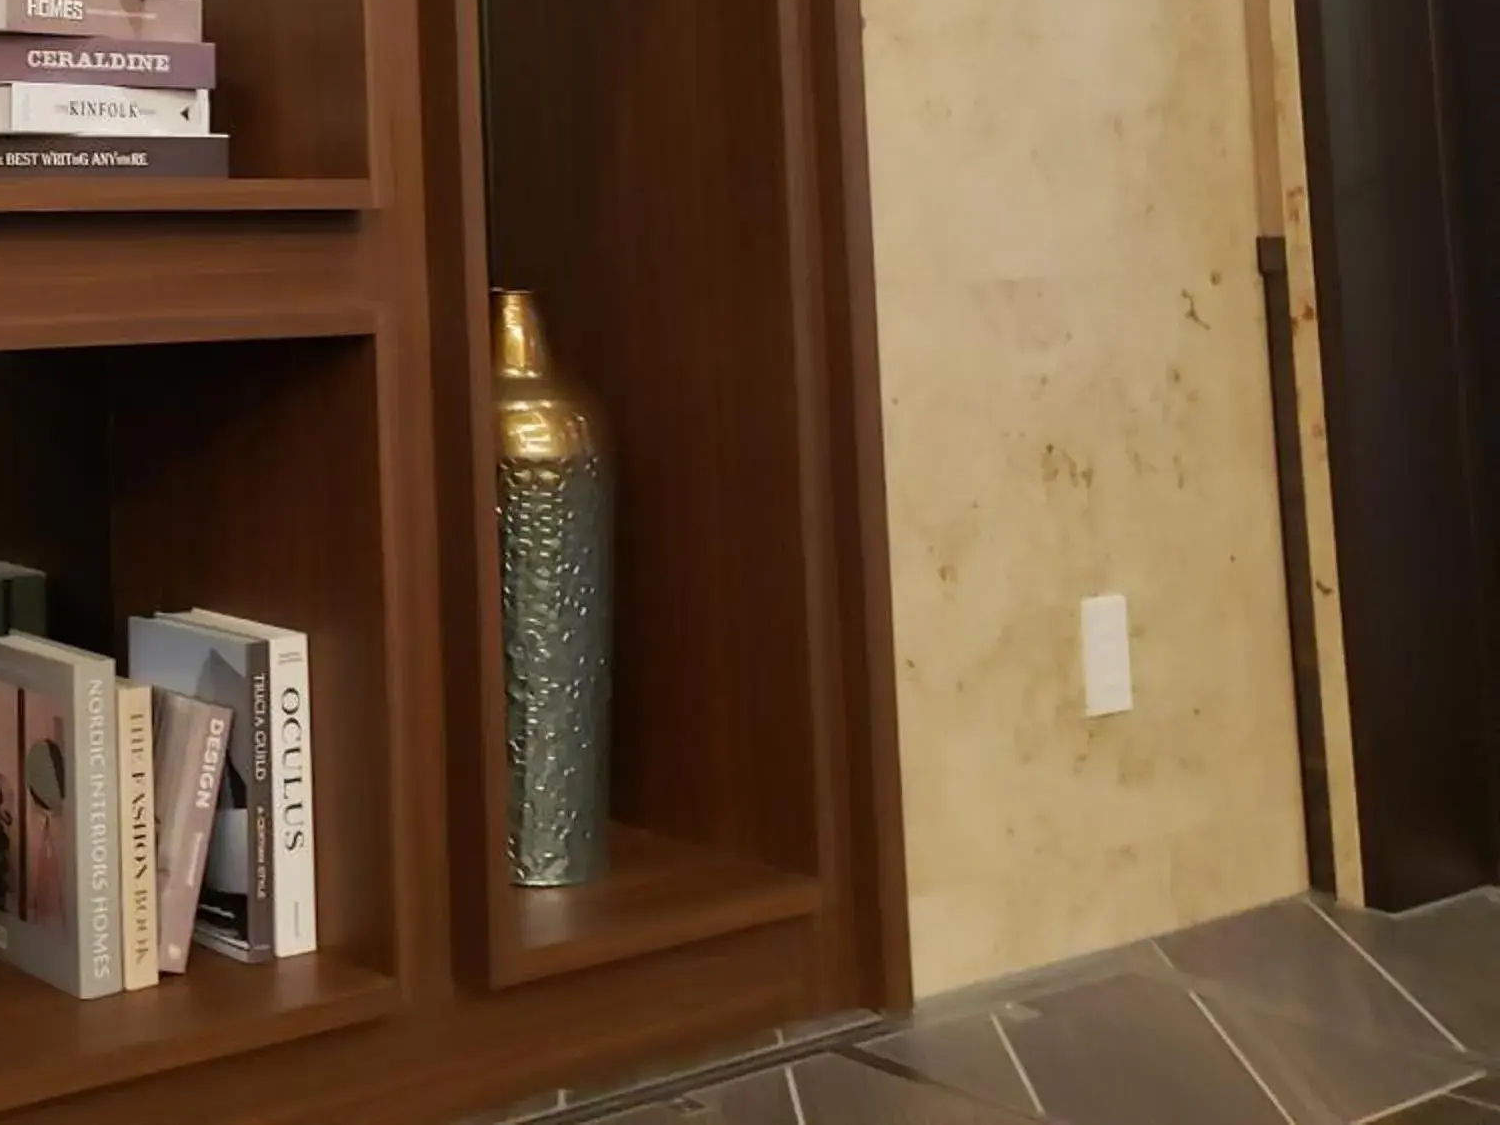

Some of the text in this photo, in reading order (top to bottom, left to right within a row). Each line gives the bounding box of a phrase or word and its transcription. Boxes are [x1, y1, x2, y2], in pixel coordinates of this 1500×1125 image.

[5, 152, 40, 167] BEST
[68, 100, 139, 119] KINFOLK
[129, 712, 146, 763] THE
[196, 717, 226, 809] DESIGN
[252, 672, 269, 782] TRICIA GUILD
[280, 686, 305, 852] OCULUS
[87, 678, 111, 980] NORDIC INTERIORS HOMES
[131, 771, 149, 881] FASHION
